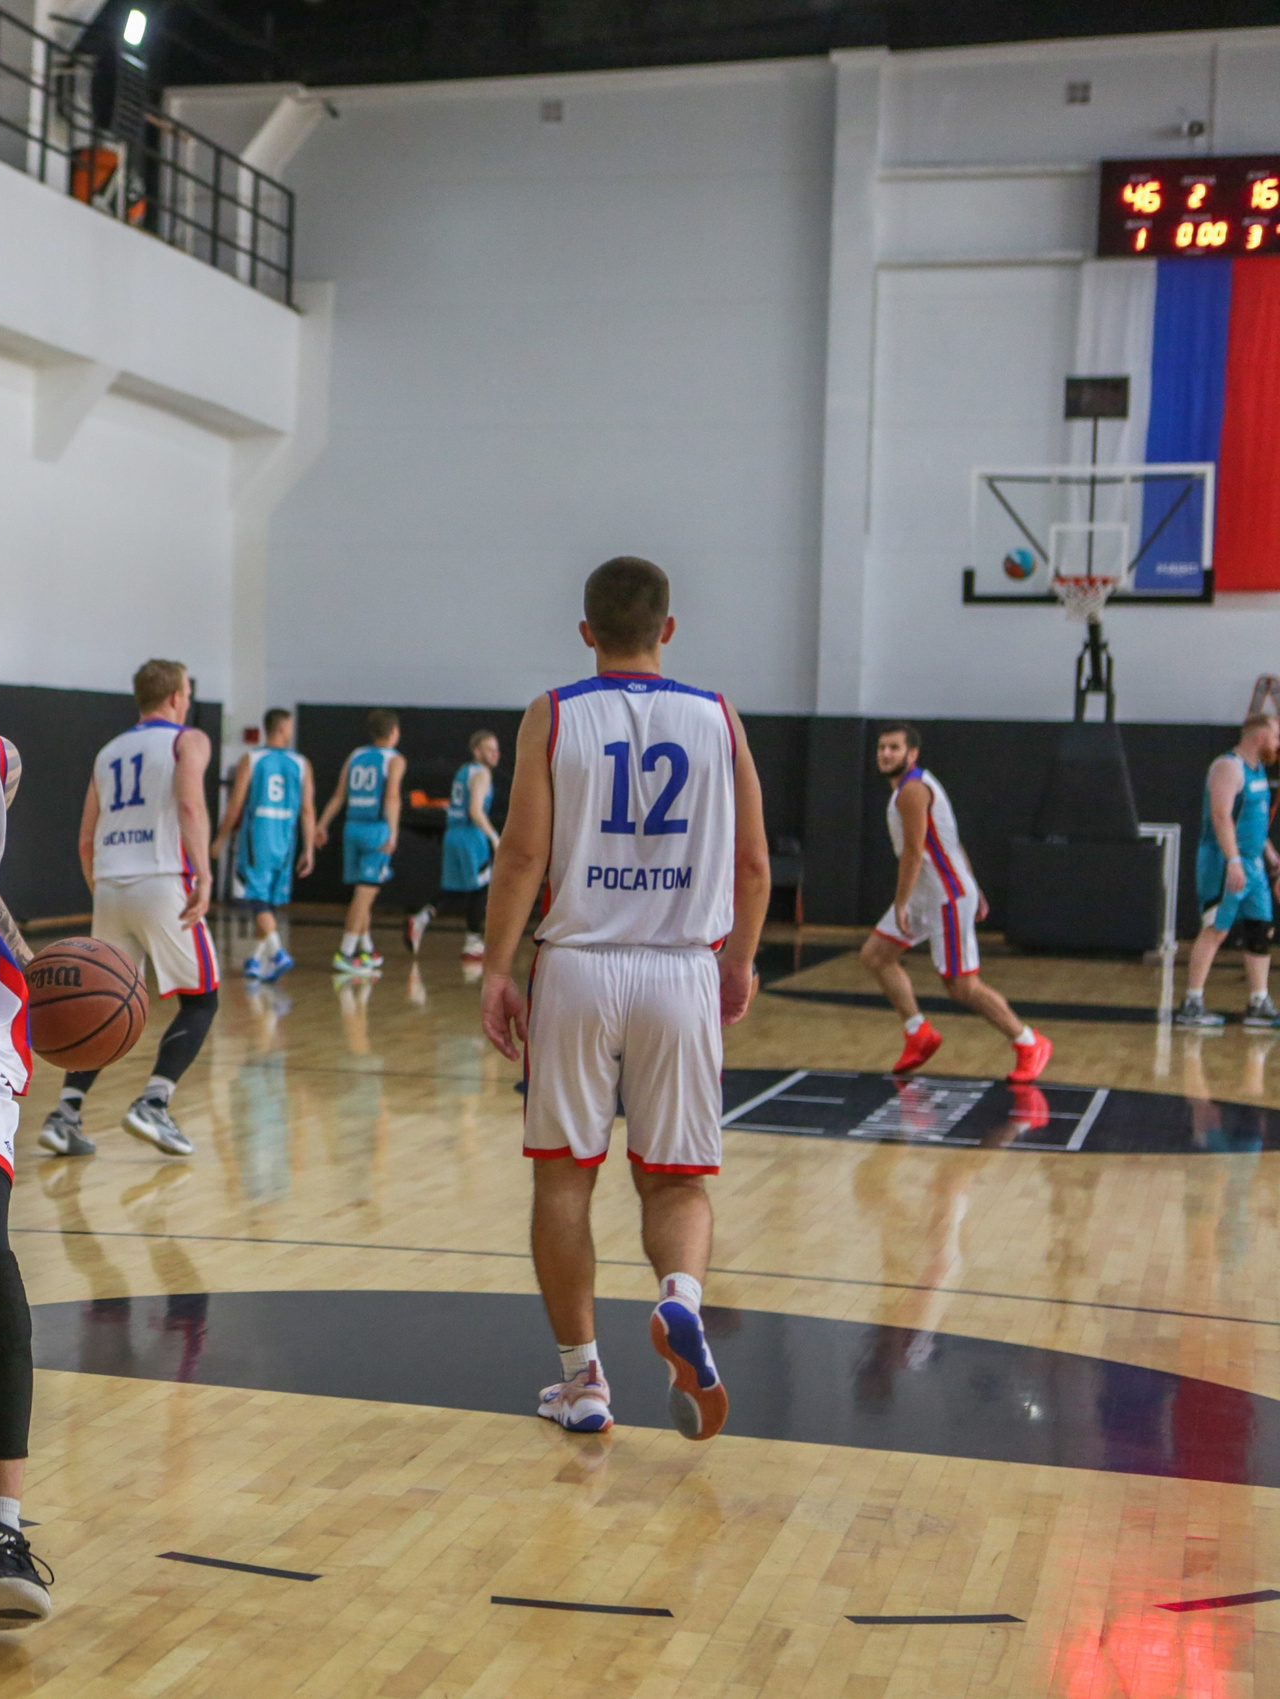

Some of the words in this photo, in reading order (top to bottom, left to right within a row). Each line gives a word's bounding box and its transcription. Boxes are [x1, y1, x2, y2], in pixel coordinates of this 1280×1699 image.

[1123, 181, 1161, 213] 46
[1188, 183, 1206, 209] 2
[1251, 178, 1279, 210] 16
[1135, 227, 1147, 251] 1
[109, 753, 145, 811] 11
[268, 773, 284, 802] 6
[350, 765, 377, 791] 00
[600, 741, 689, 836] 12
[586, 866, 692, 890] РОСАТОМ
